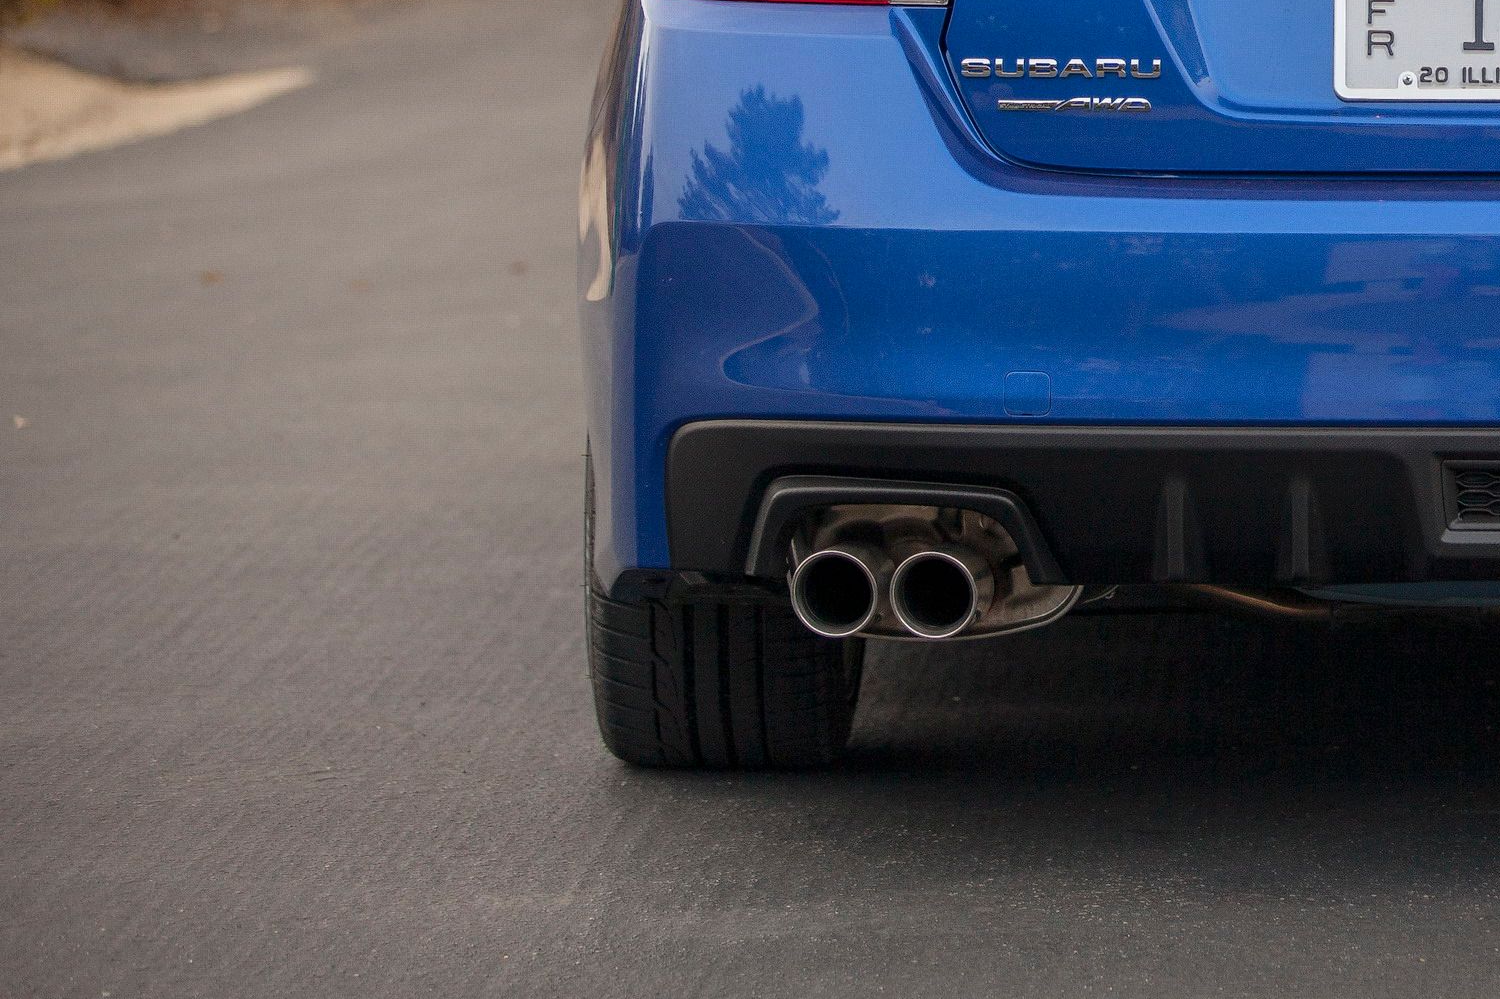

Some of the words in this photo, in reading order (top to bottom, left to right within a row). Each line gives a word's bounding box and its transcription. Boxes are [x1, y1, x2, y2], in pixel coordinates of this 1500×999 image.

[960, 57, 1162, 79] SUBARU
[1418, 66, 1449, 84] 20
[1055, 96, 1153, 112] AWD
